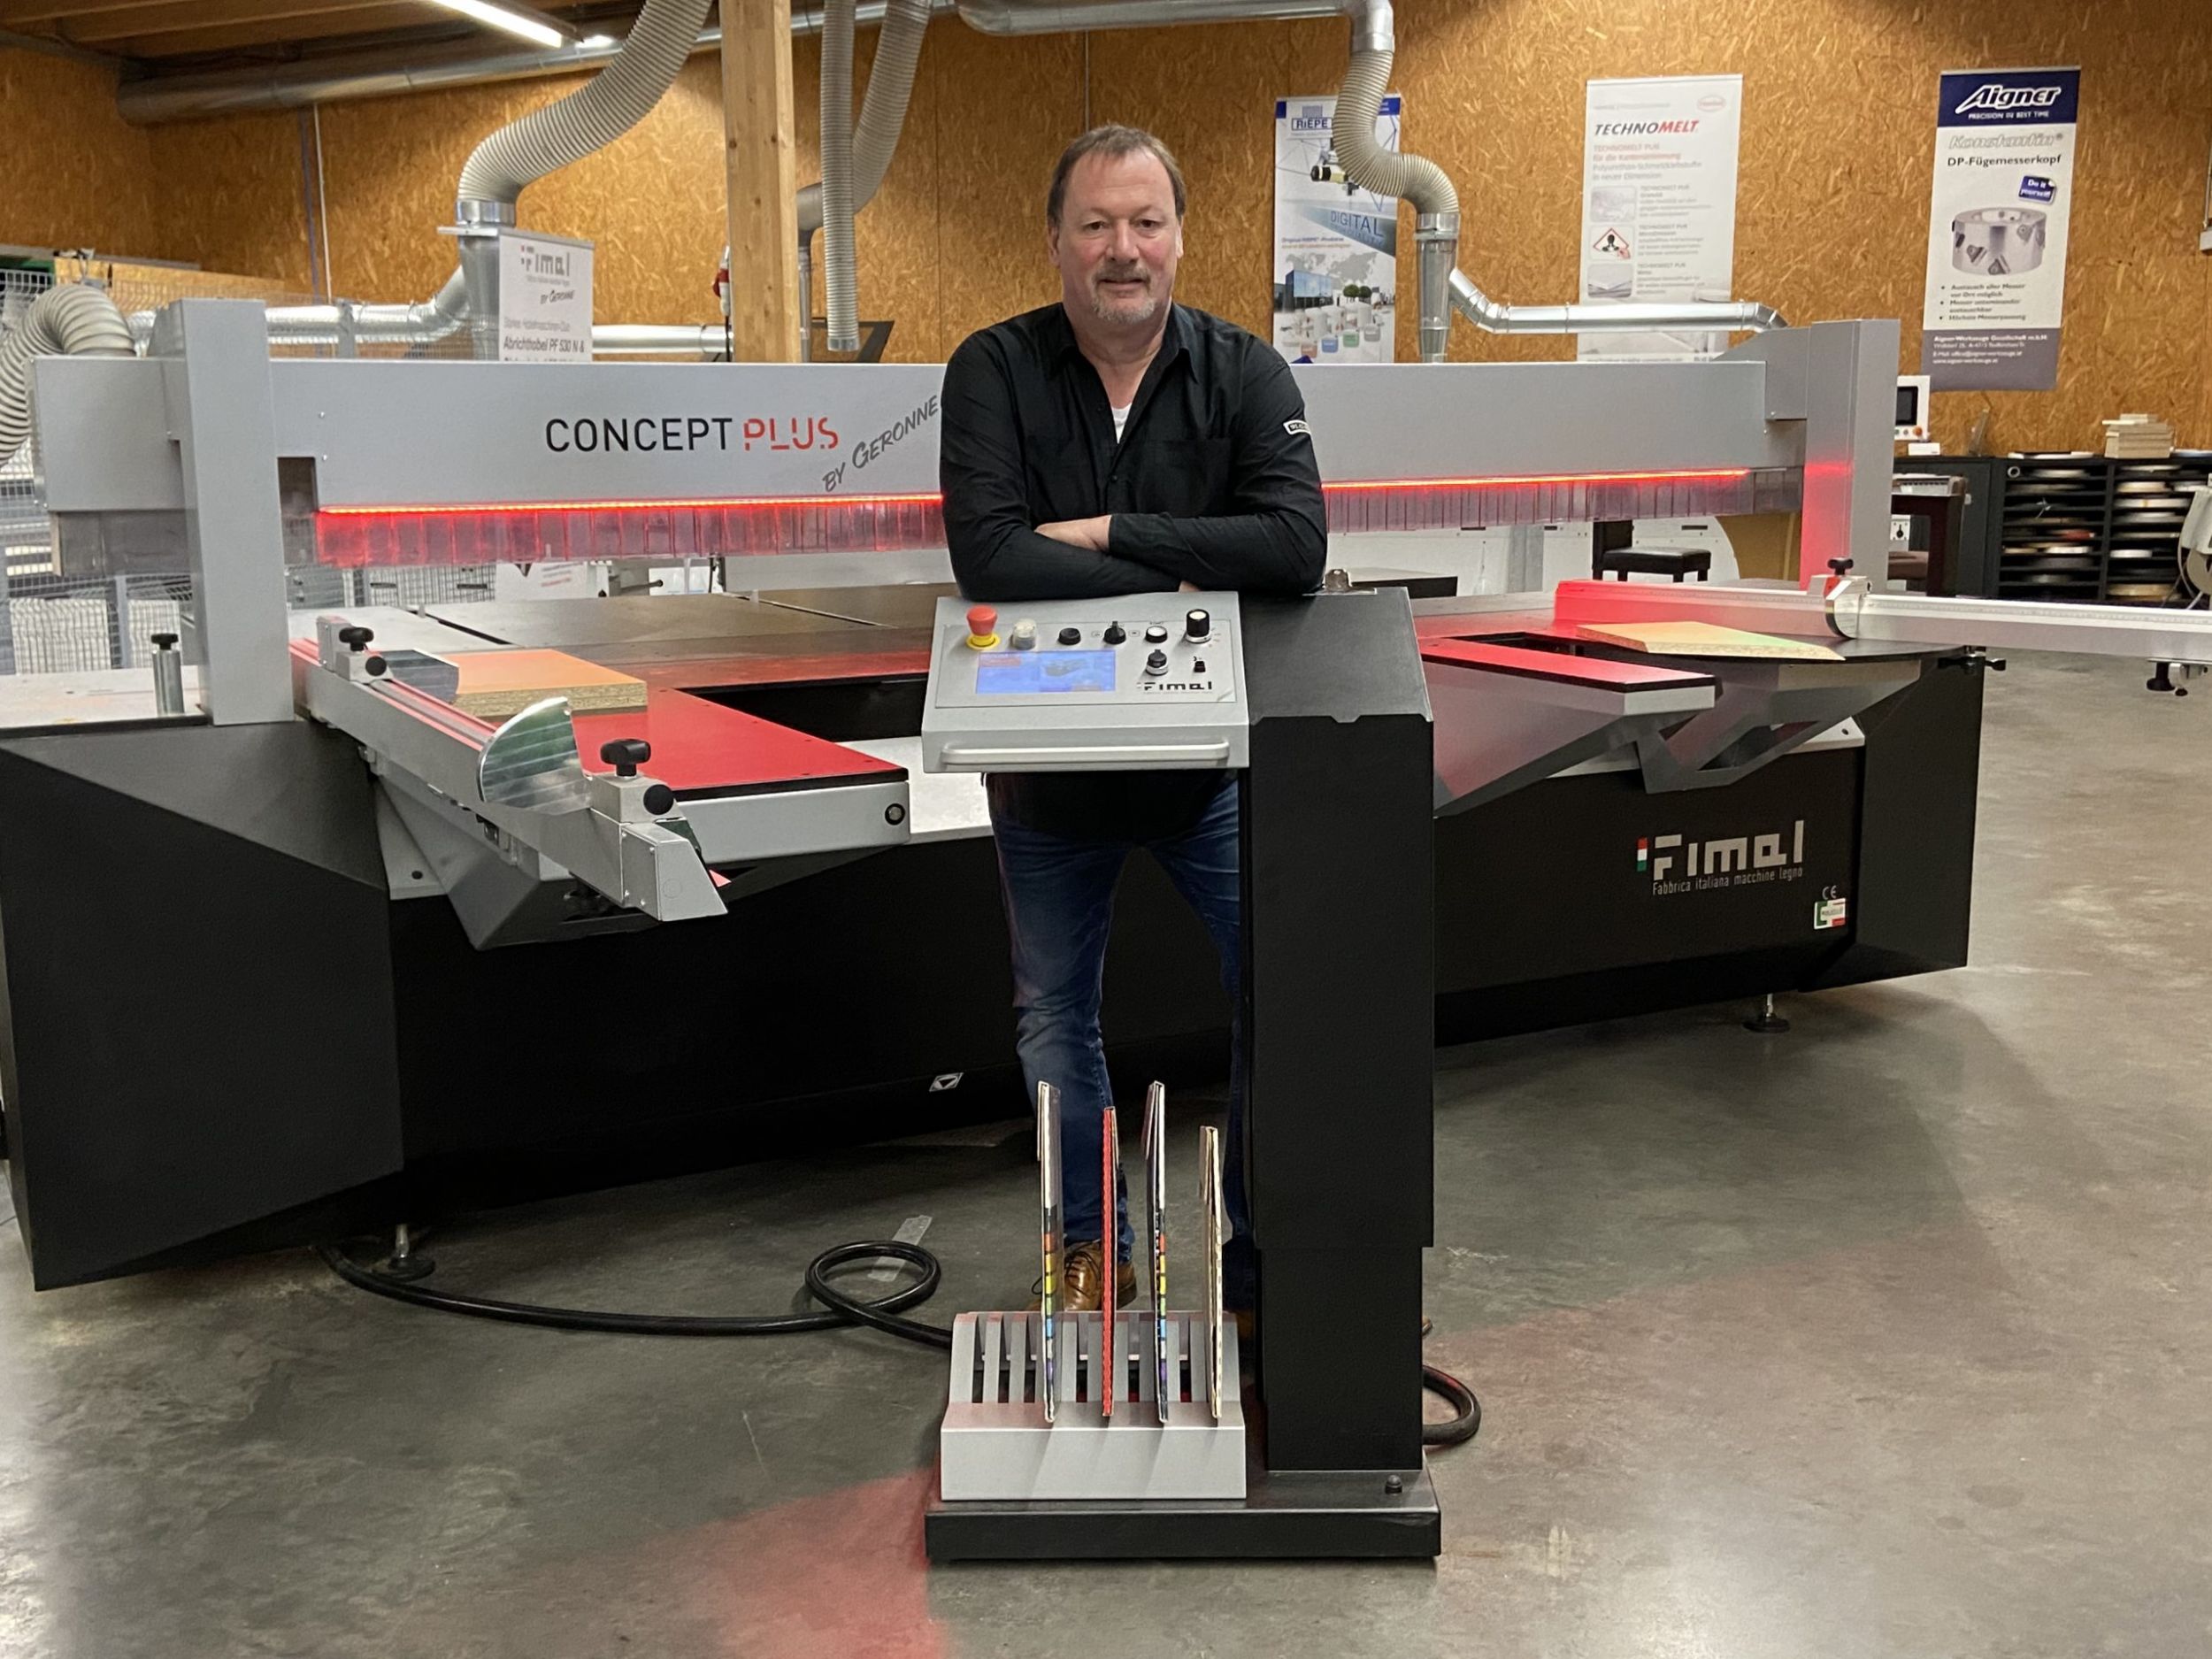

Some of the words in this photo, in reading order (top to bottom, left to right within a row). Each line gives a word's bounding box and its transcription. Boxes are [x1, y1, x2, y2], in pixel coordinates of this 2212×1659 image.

[1955, 84, 2062, 114] Aigner
[1594, 120, 1700, 135] TECHNOMELT
[1947, 154, 2062, 168] DP-Fügemesserkopf
[1330, 210, 1385, 238] DIGITAL
[545, 418, 733, 453] CONCEPT
[743, 416, 839, 451] PLUS
[822, 462, 847, 493] BY
[852, 395, 939, 469] GERONNE
[1144, 680, 1212, 691] Fimal
[1653, 819, 1805, 881] Fimal
[1652, 879, 1691, 896] Fabbrica
[1695, 875, 1729, 890] italiana
[1733, 868, 1775, 885] macchine
[1778, 865, 1803, 883] legno
